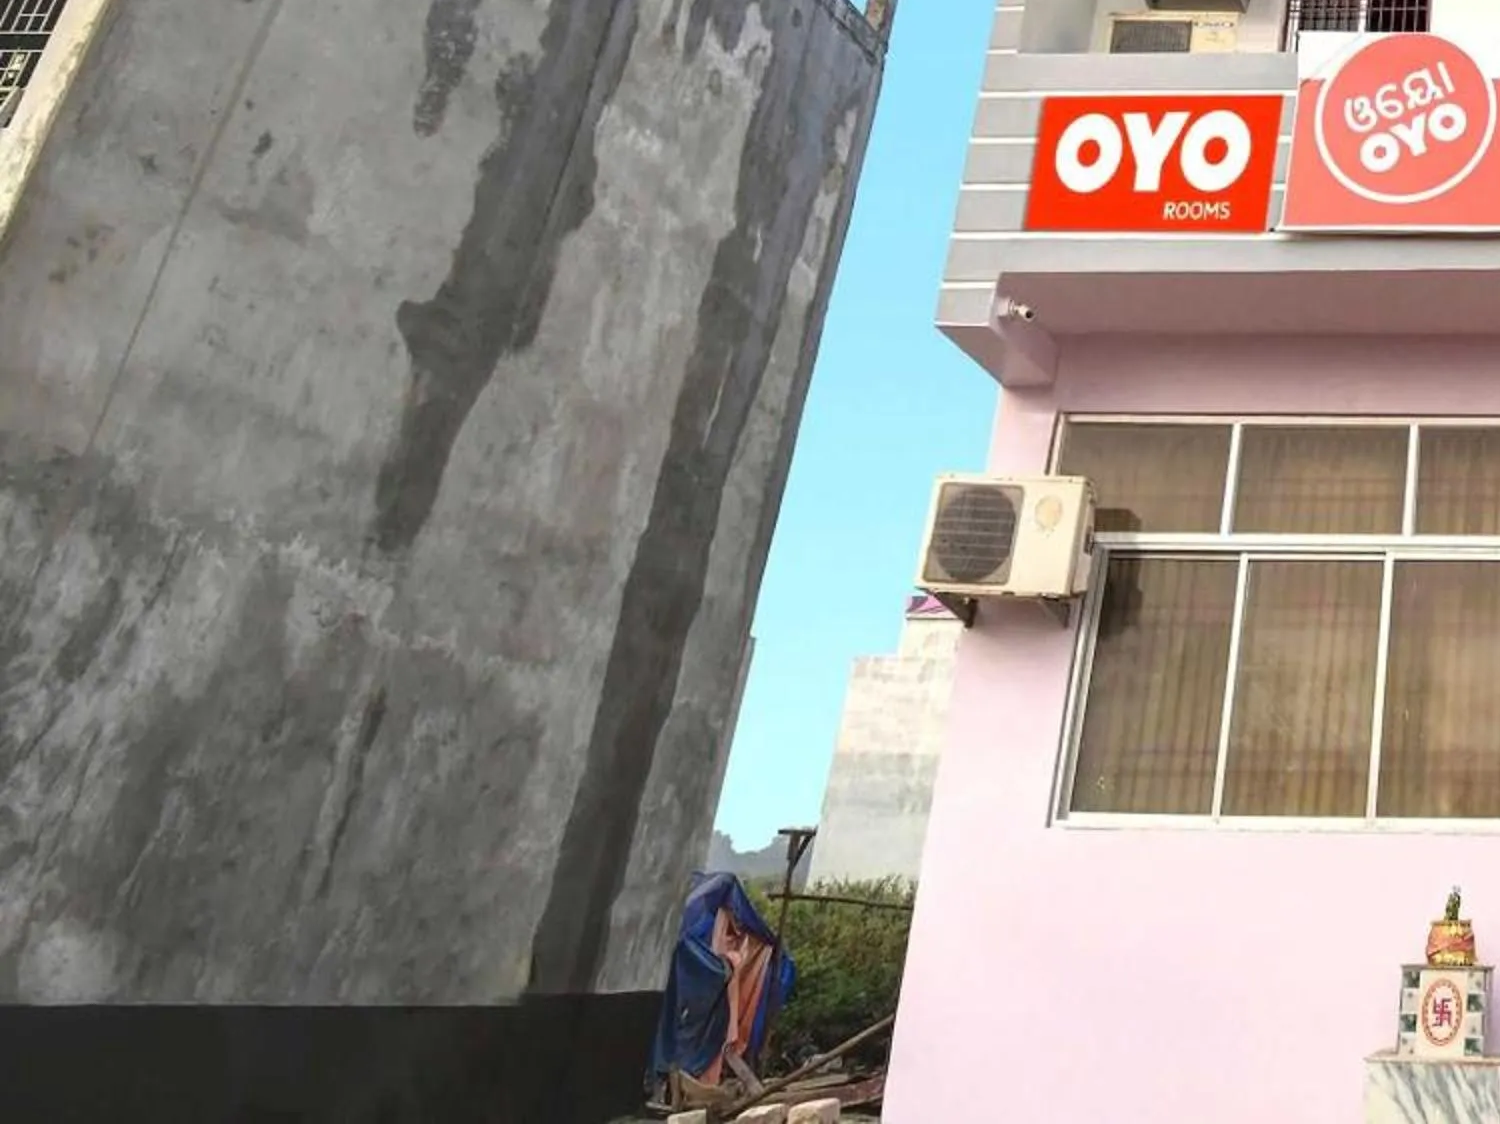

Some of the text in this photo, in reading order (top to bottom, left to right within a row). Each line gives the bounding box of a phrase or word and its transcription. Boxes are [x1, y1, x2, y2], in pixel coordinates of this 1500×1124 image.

[1055, 109, 1252, 193] OYO
[1359, 103, 1467, 173] OYO
[1162, 201, 1231, 221] ROOMS
